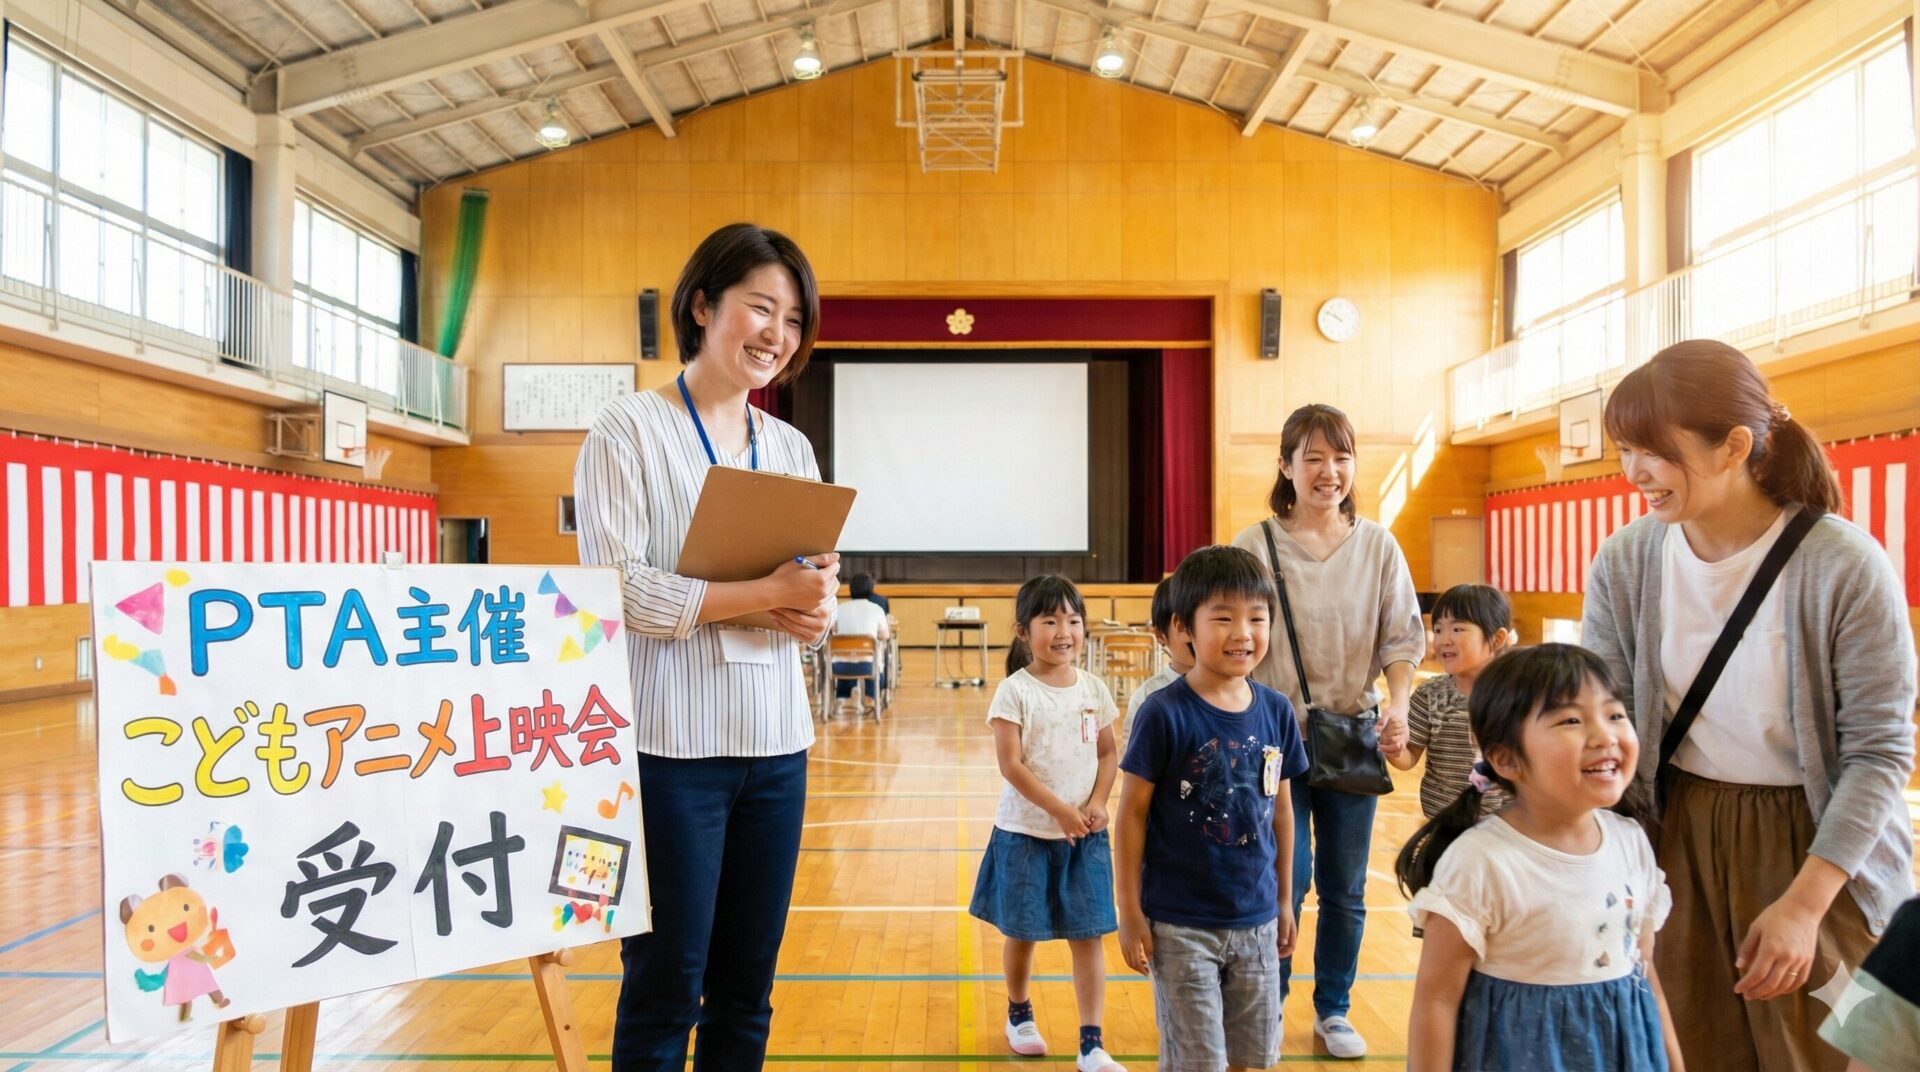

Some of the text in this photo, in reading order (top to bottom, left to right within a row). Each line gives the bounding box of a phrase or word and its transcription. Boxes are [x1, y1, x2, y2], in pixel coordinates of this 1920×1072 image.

[188, 585, 530, 676] PTA主催
[121, 684, 631, 806] こどもアニメ上映会
[280, 811, 526, 968] 受付
